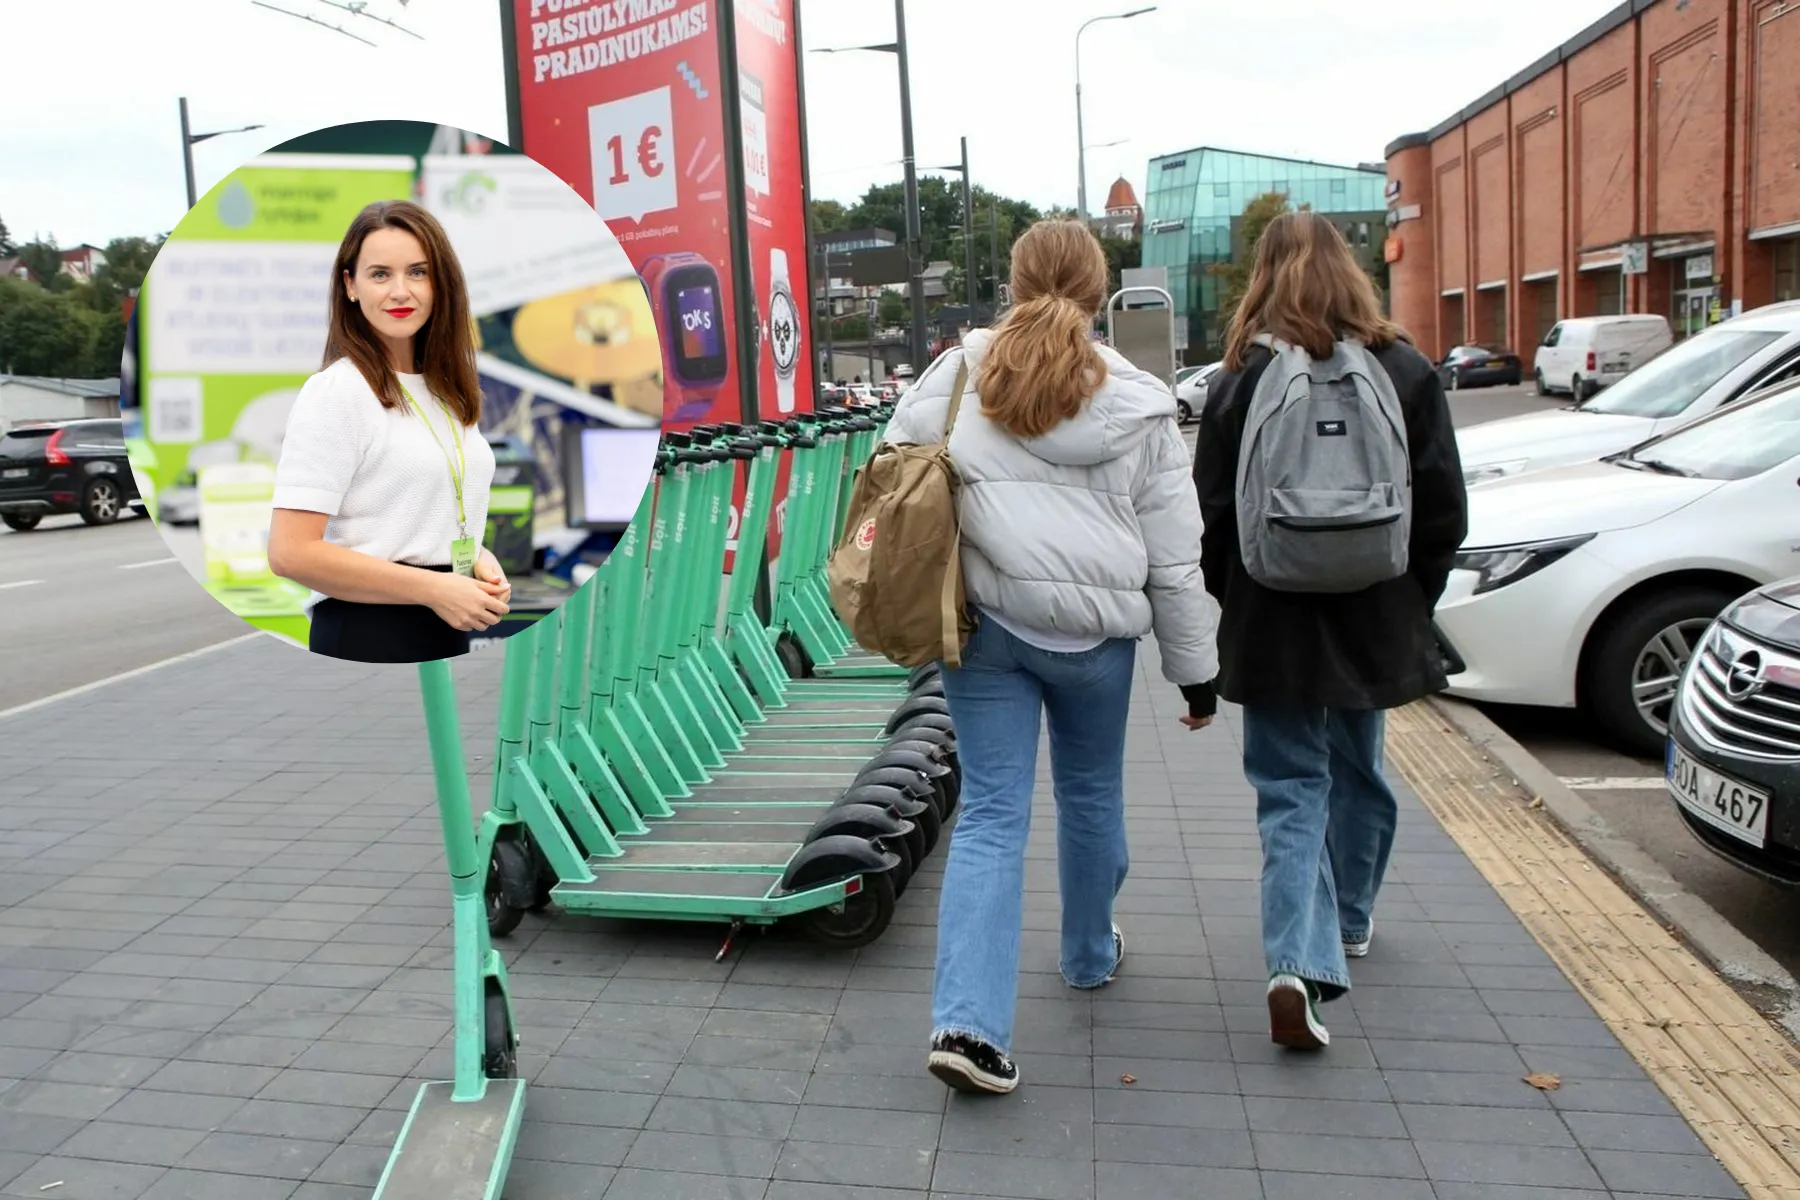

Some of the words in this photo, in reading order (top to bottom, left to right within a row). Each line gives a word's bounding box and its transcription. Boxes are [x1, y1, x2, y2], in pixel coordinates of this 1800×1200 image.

[533, 3, 708, 82] PRADINUKAMS!
[606, 134, 629, 186] 1
[637, 125, 664, 178] €
[1714, 781, 1763, 829] 467
